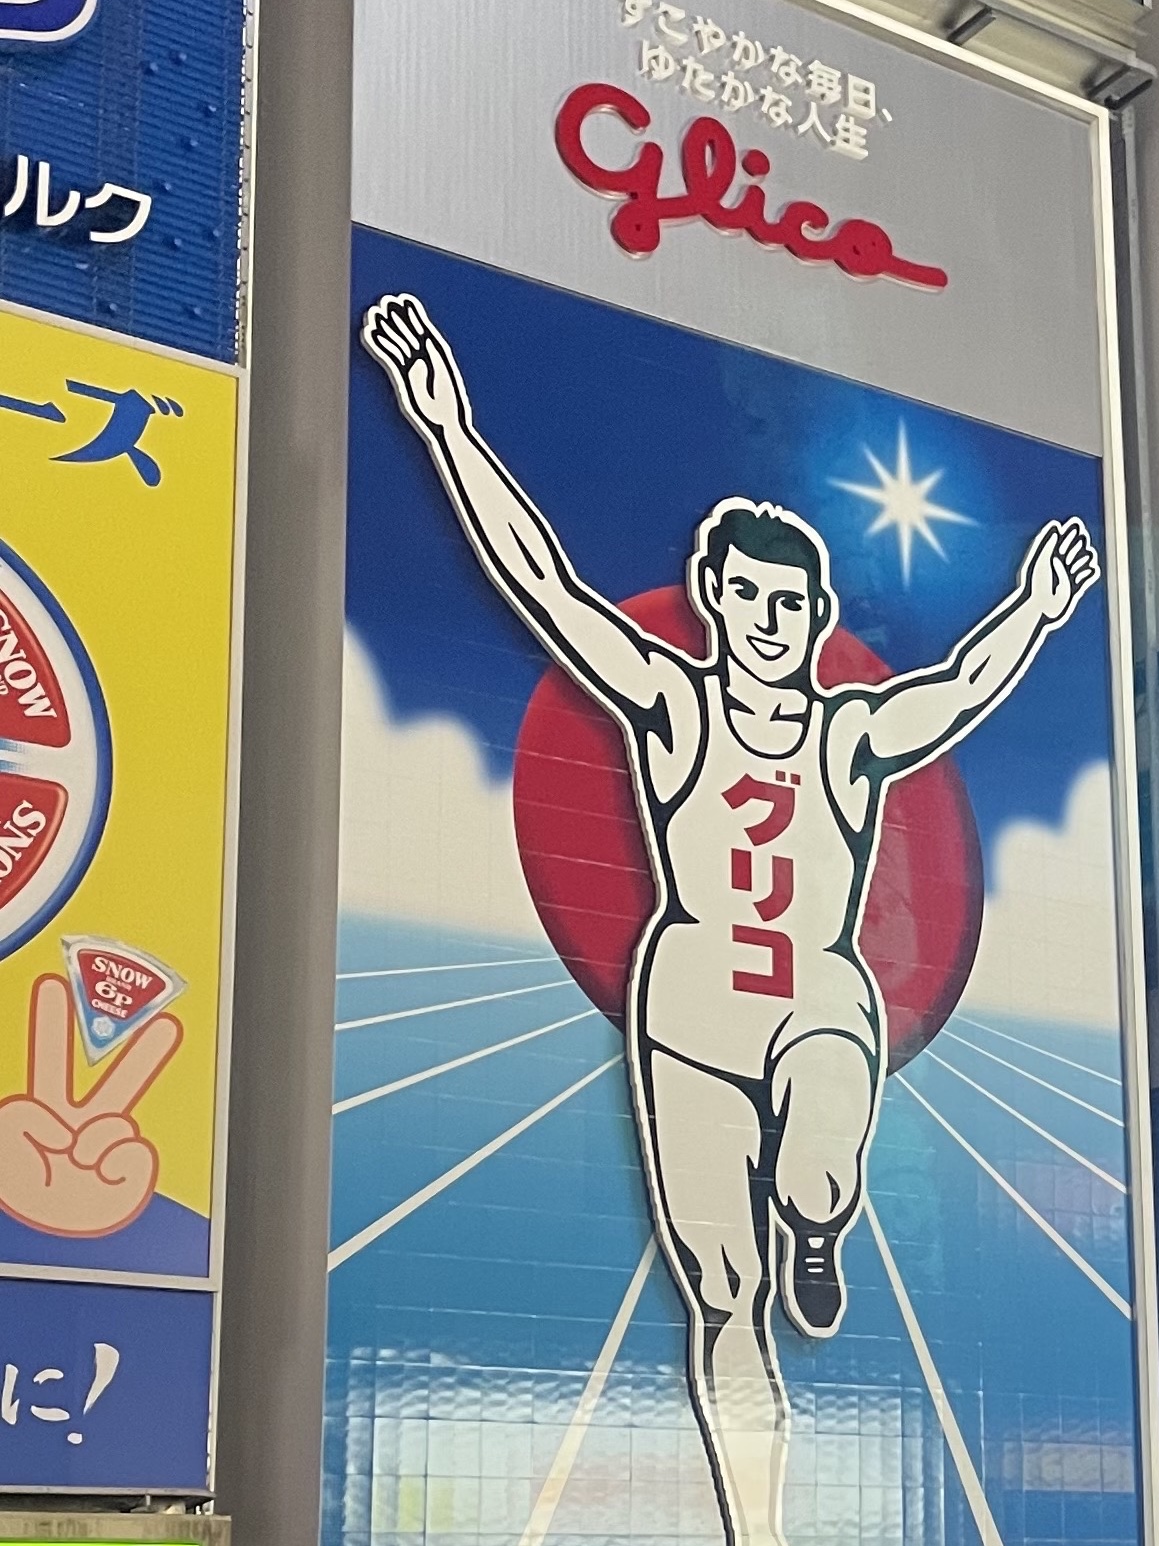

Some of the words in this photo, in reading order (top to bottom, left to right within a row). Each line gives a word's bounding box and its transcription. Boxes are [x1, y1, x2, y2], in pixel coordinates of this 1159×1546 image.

[639, 40, 869, 160] ゆたかな人生
[555, 83, 948, 290] Glico
[721, 770, 801, 999] グリコ
[91, 957, 153, 989] SNOW
[95, 981, 133, 1007] 6P
